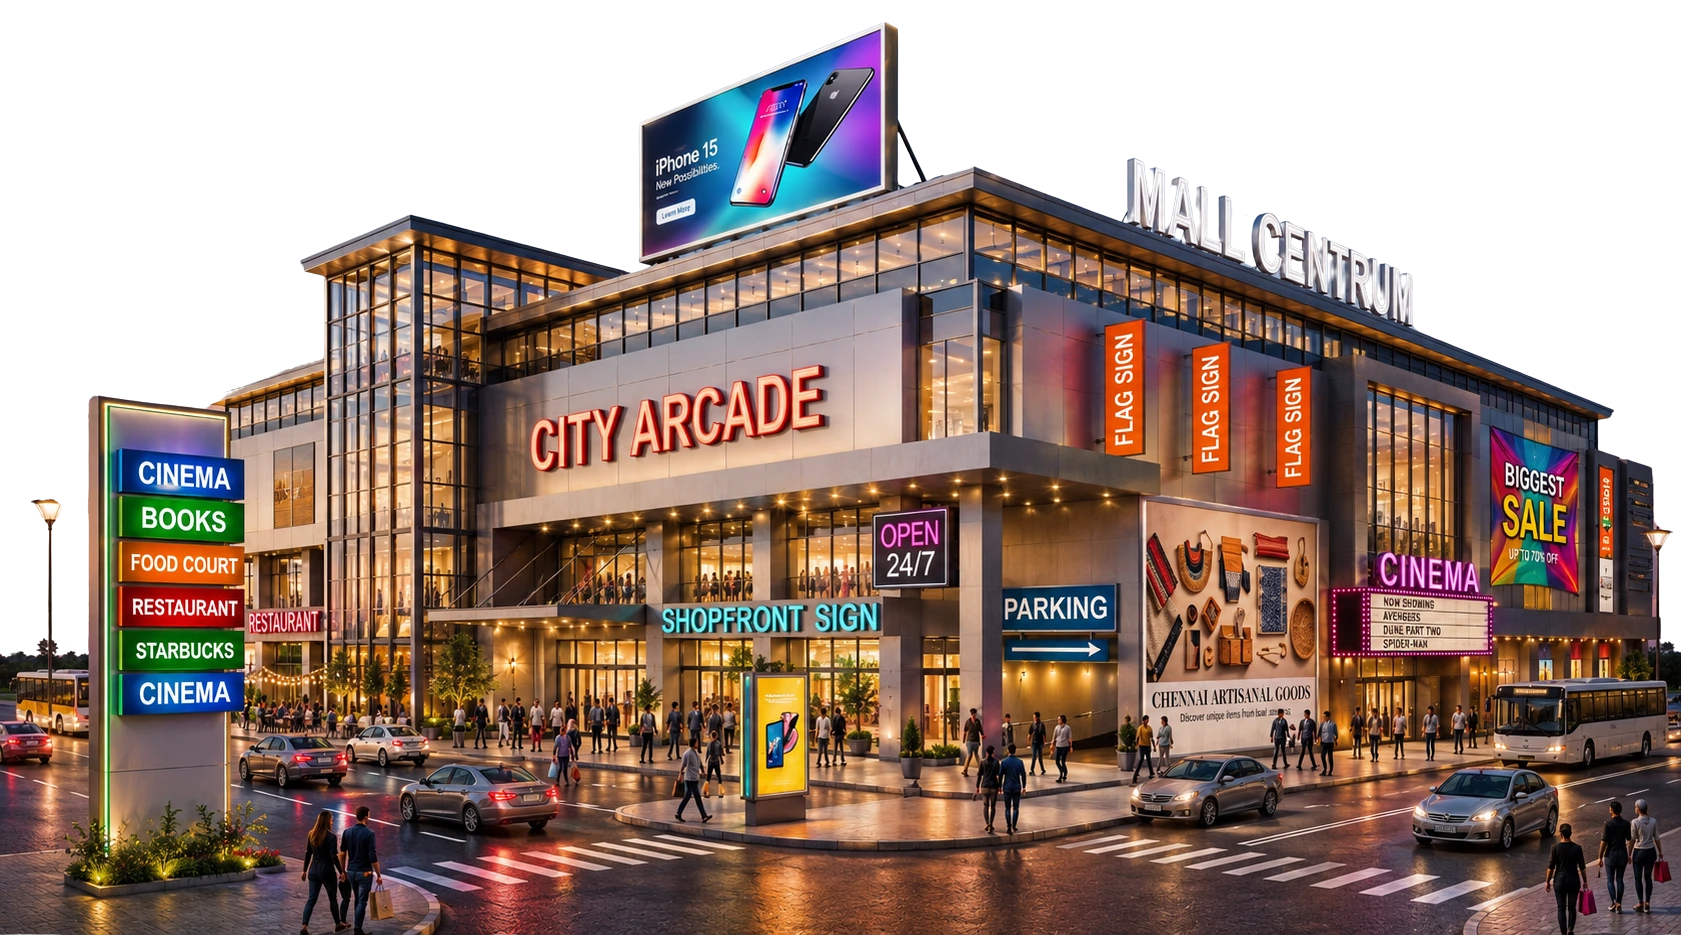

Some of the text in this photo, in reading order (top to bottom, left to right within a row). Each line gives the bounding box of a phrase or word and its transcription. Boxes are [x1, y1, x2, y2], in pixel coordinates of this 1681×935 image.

[655, 137, 718, 176] iPhone 15
[655, 178, 672, 191] New
[1127, 157, 1417, 326] MALL CENTRUM
[1114, 332, 1134, 447] FLAG SIGN
[530, 364, 826, 472] CITY ARCADE
[1201, 355, 1220, 464] FLAG SIGN
[1285, 377, 1302, 479] FLAG SIGN
[138, 460, 231, 491] CINEMA
[1505, 461, 1565, 498] BIGGEST
[141, 506, 227, 534] BOOKS
[880, 519, 940, 548] OPEN
[1502, 494, 1568, 545] SALE
[130, 553, 238, 575] FOOD COURT
[886, 550, 936, 578] 24/7
[1508, 548, 1519, 560] UP
[1546, 552, 1559, 564] OFF
[1381, 553, 1478, 592] CINEMA
[131, 597, 238, 618] RESTAURANT
[248, 611, 318, 633] RESTAURANT
[661, 602, 881, 634] SHOPFRONT SIGN
[1004, 595, 1108, 620] PARKING
[135, 641, 235, 661] STARBUCKS
[139, 681, 231, 706] CINEMA
[1151, 684, 1311, 709] CHENNAI ARTISANAL GOODS
